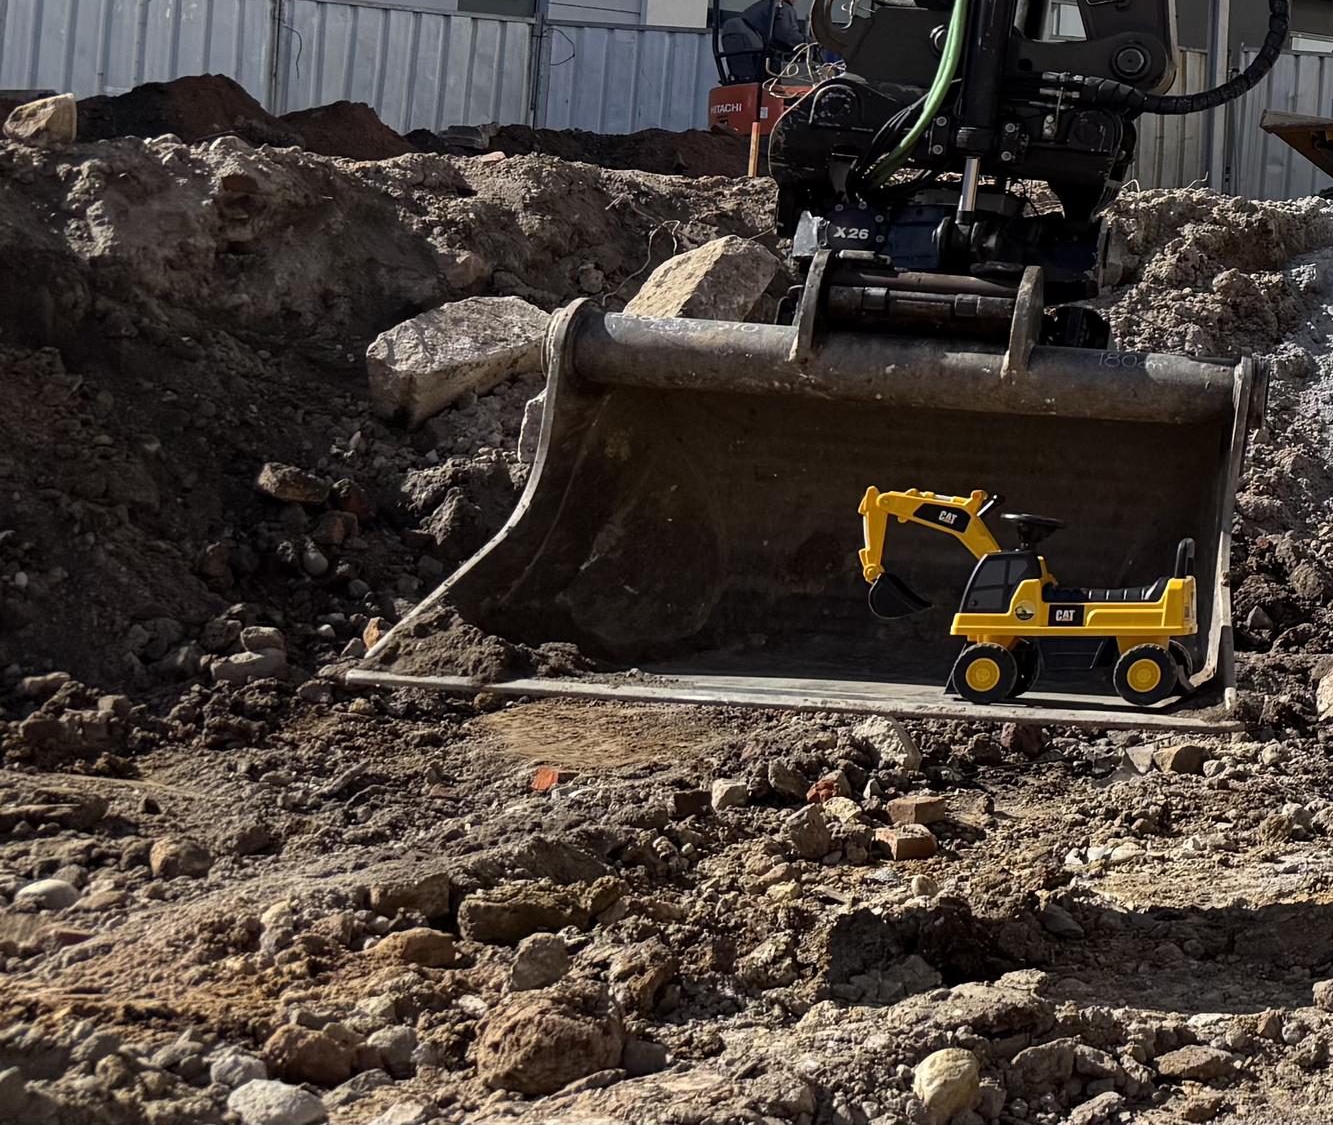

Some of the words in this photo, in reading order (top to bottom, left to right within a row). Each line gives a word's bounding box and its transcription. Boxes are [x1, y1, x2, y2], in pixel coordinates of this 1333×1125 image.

[710, 103, 742, 114] HITACHI
[938, 510, 958, 525] CAT
[1055, 609, 1075, 622] CAT
